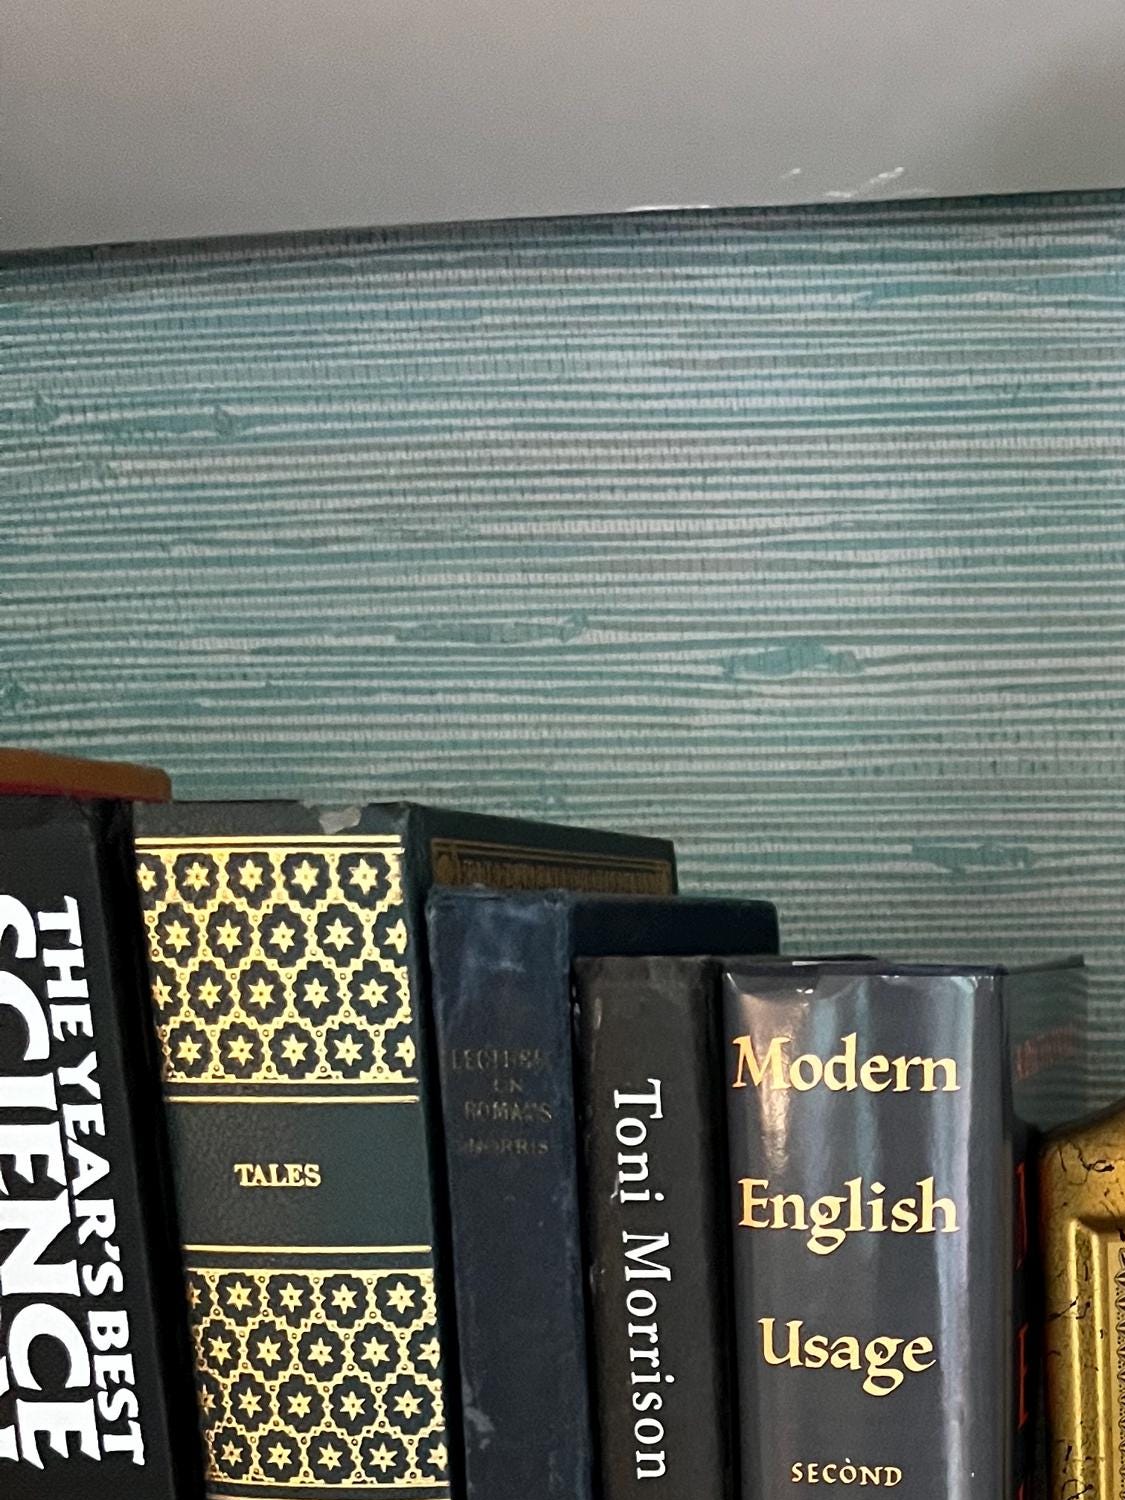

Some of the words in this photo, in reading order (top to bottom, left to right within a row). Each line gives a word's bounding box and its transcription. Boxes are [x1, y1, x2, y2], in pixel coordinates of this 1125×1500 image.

[37, 895, 94, 1042] THE
[732, 1032, 960, 1093] Modern
[57, 1050, 124, 1297] YEAR'S
[233, 1163, 322, 1187] TALES
[613, 1078, 665, 1204] Toni
[737, 1175, 960, 1255] English
[87, 1310, 146, 1466] BEST
[622, 1230, 675, 1481] Morrison
[758, 1317, 937, 1396] Usage
[791, 1462, 902, 1487] SECOND
